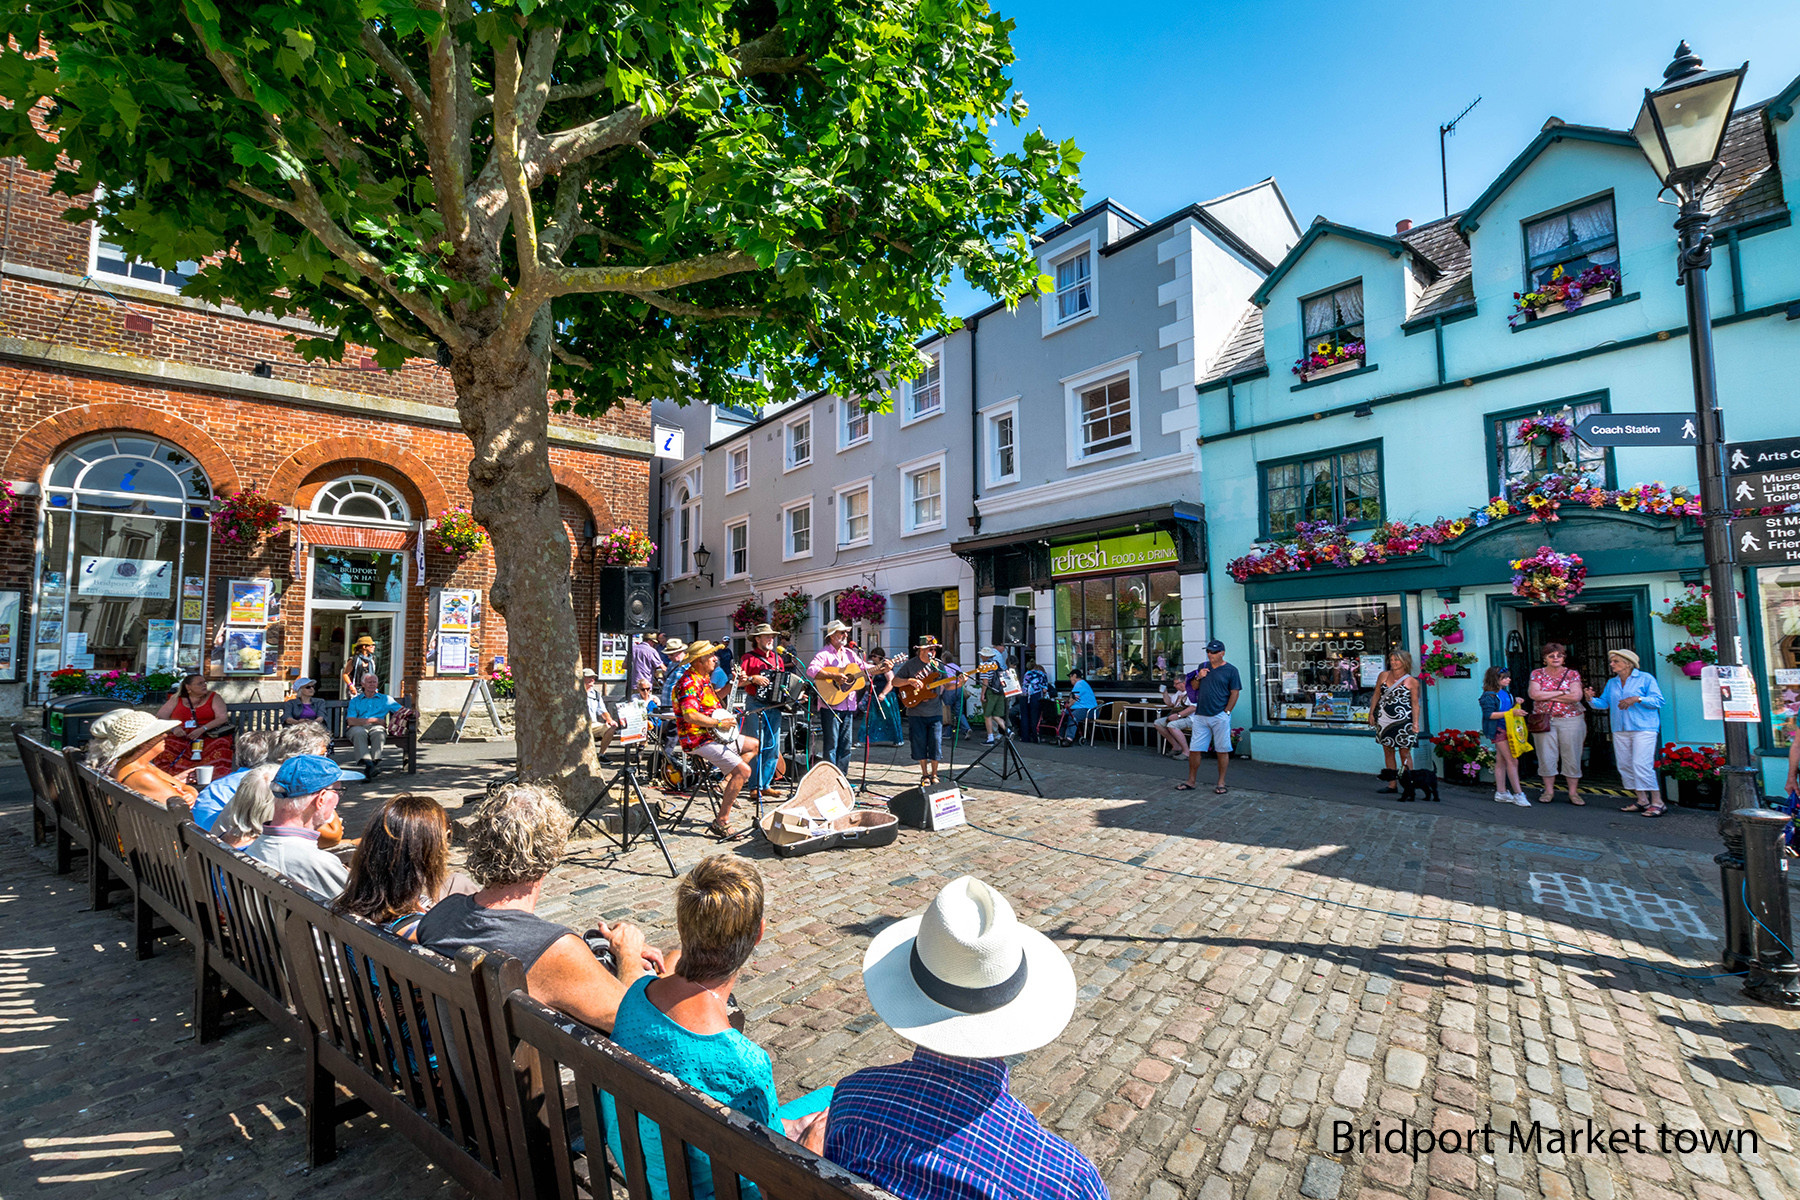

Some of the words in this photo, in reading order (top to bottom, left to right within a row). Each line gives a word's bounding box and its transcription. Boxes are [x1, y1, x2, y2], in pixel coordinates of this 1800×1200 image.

[1591, 425, 1624, 435] Coach
[1624, 424, 1660, 434] Station
[1758, 452, 1788, 462] Arts
[1766, 518, 1782, 528] St
[1767, 529, 1796, 538] The
[1051, 544, 1108, 572] refresh
[1112, 552, 1136, 565] FOOD
[1138, 552, 1145, 561] &
[1148, 548, 1177, 560] DRINK
[340, 566, 378, 575] BRIDPORT
